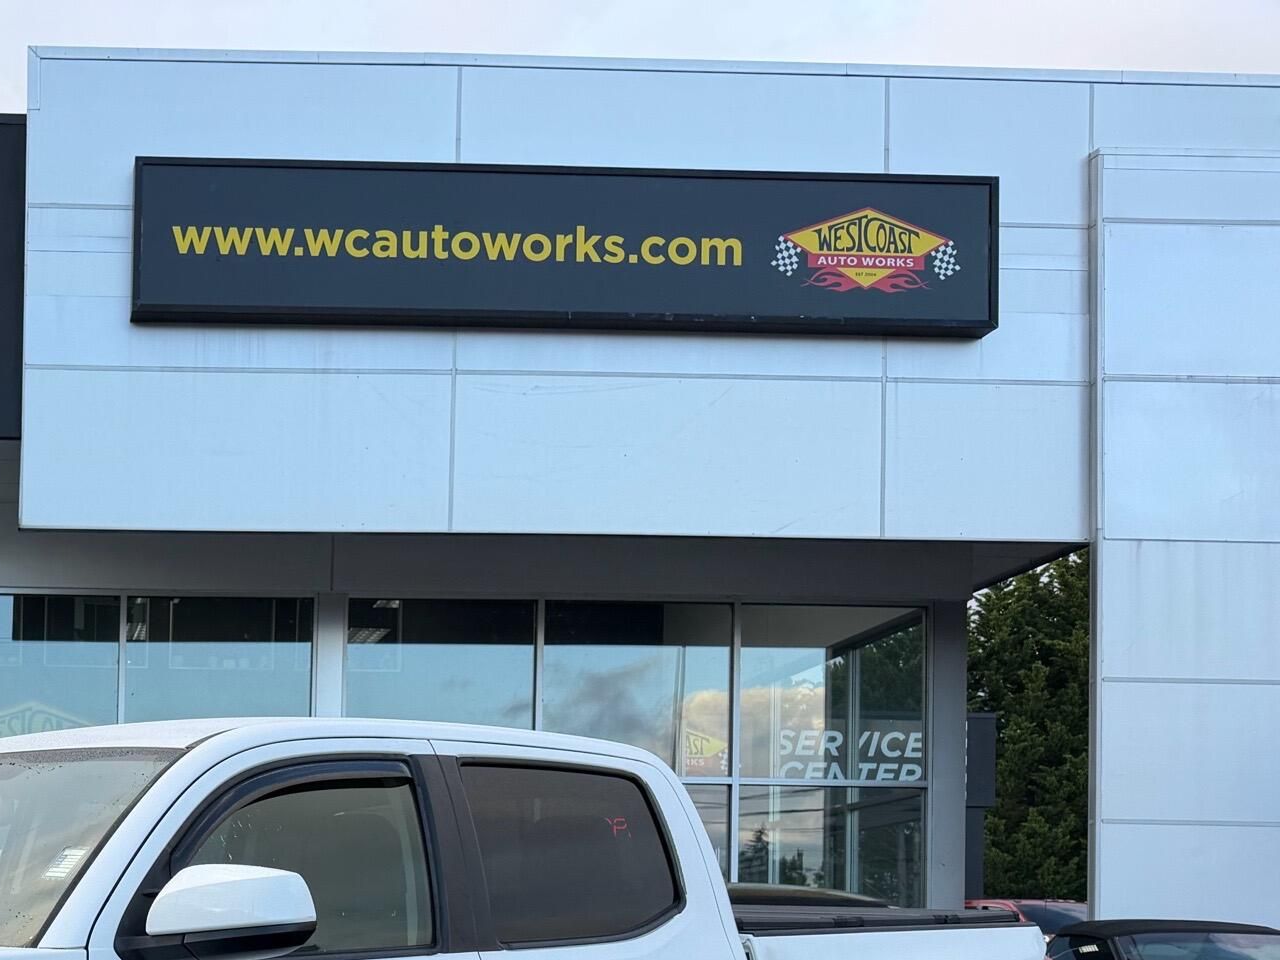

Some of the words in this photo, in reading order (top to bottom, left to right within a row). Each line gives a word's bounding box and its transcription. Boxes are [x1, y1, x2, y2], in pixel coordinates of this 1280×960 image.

[172, 225, 743, 266] www.wcautoworks.com
[817, 256, 858, 266] AUTO
[862, 257, 915, 268] WORKS
